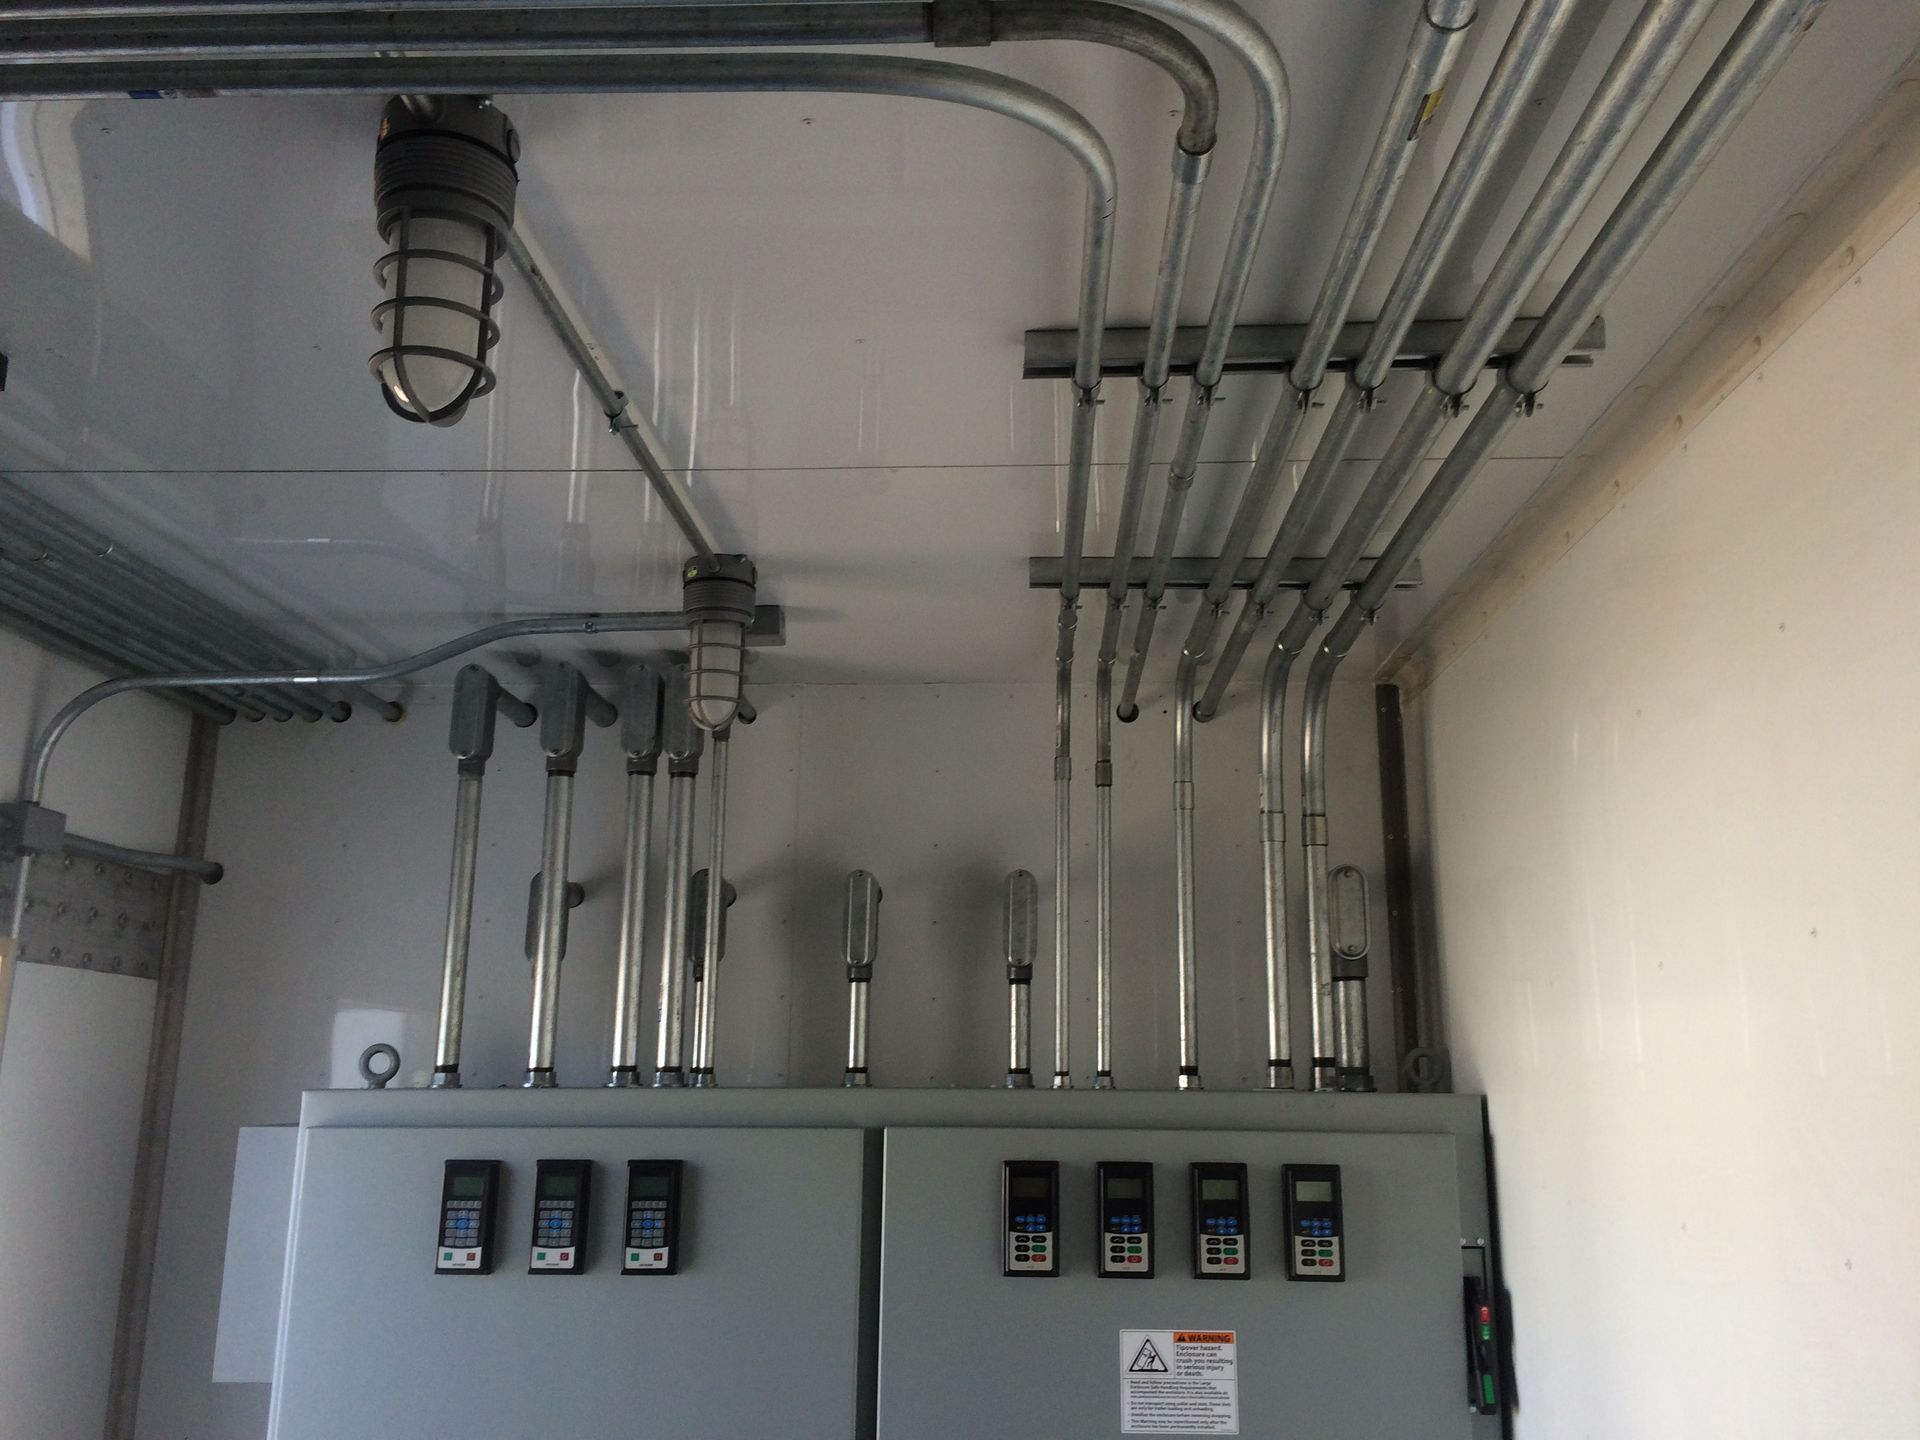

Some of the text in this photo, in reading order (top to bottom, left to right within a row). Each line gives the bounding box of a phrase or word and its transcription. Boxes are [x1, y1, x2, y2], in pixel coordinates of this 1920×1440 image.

[1188, 1334, 1231, 1343] WARNING
[1206, 1358, 1233, 1366] resulting
[1206, 1364, 1224, 1372] injury
